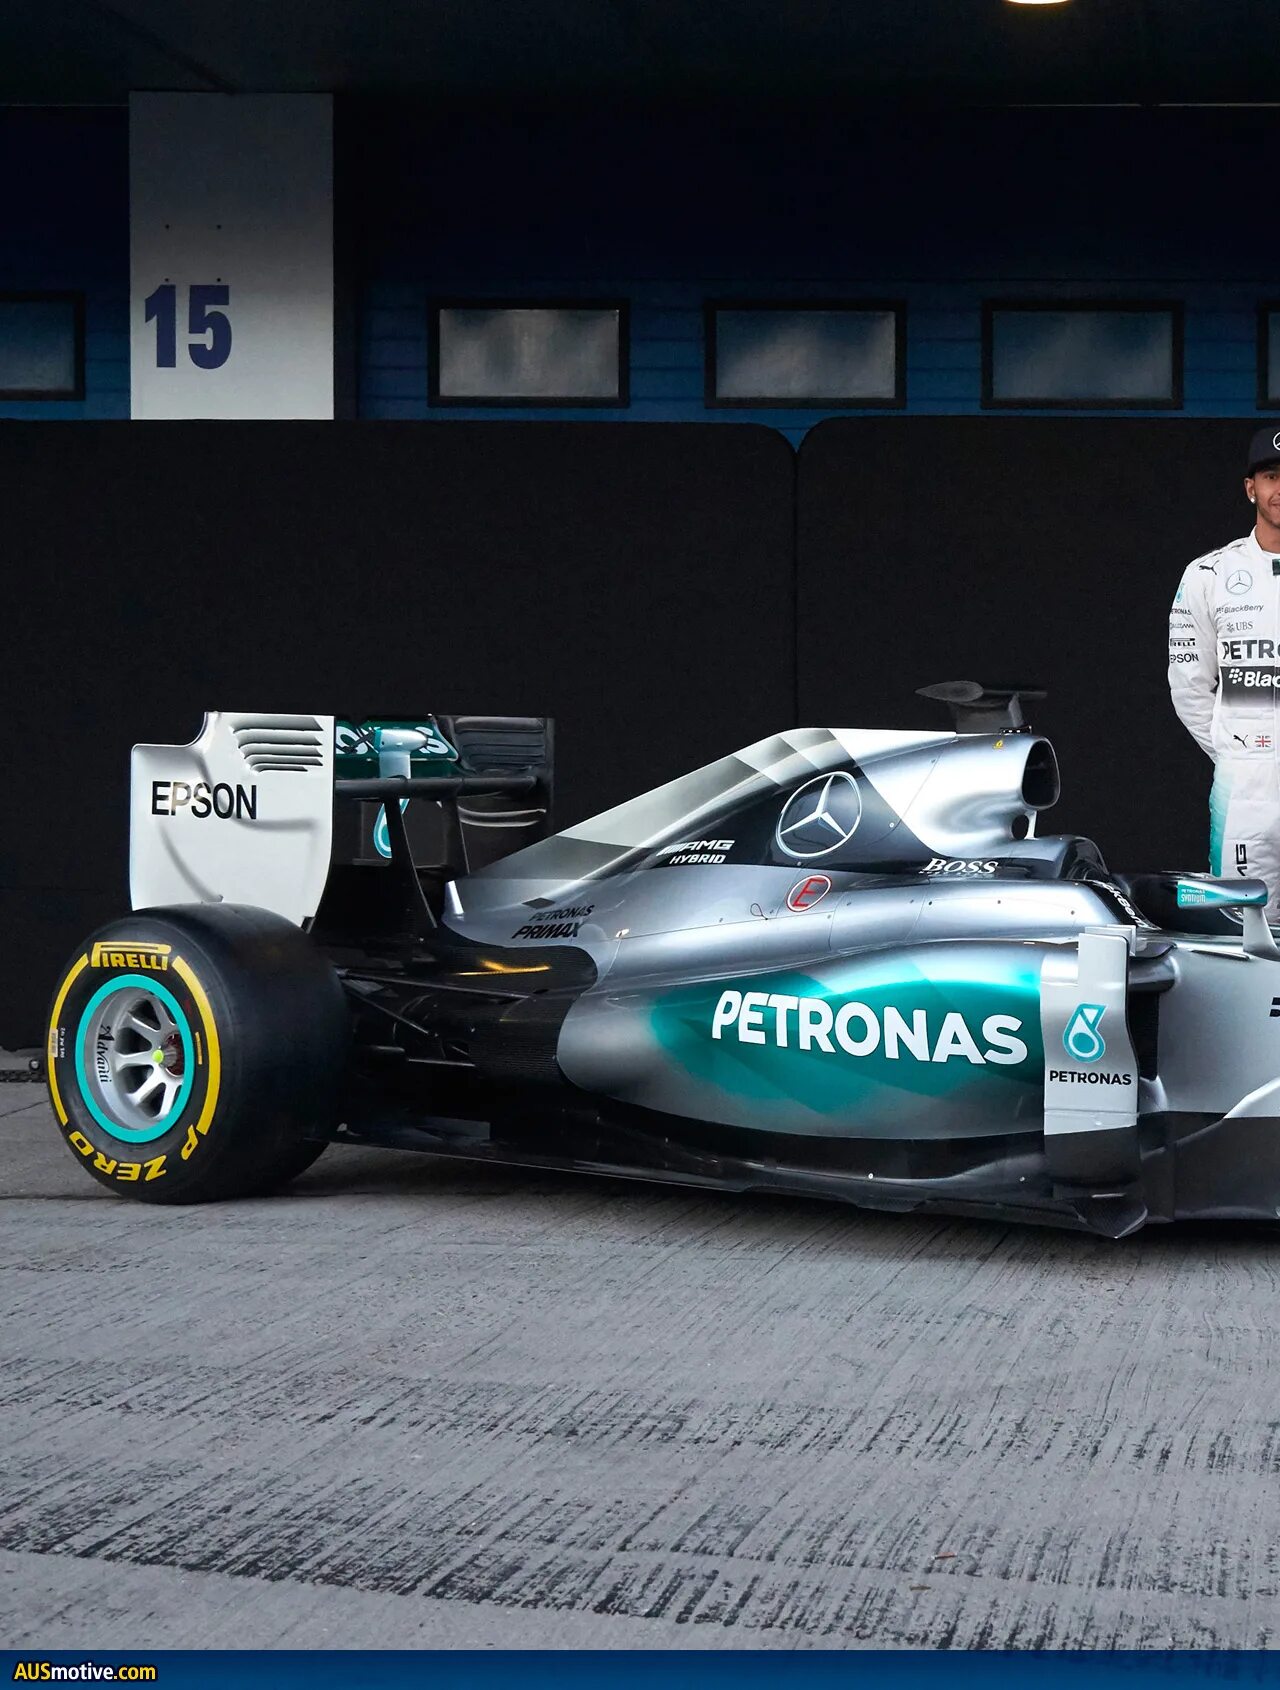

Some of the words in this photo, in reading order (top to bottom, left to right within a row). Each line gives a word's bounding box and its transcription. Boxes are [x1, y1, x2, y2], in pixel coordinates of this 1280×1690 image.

[145, 284, 232, 369] 15
[1224, 604, 1264, 614] BlackBerry
[1235, 621, 1253, 631] UBS
[151, 781, 258, 820] EPSON
[669, 854, 726, 864] HYBRID
[923, 858, 999, 874] BOSS
[792, 878, 826, 907] E
[529, 905, 595, 921] PETRONAS
[512, 922, 582, 939] PRIMAX
[91, 942, 171, 971] PIRELLI
[712, 990, 1028, 1065] PETRONAS
[1050, 1070, 1132, 1086] PETRONAS
[181, 1125, 198, 1160] P
[69, 1131, 167, 1181] ZERO
